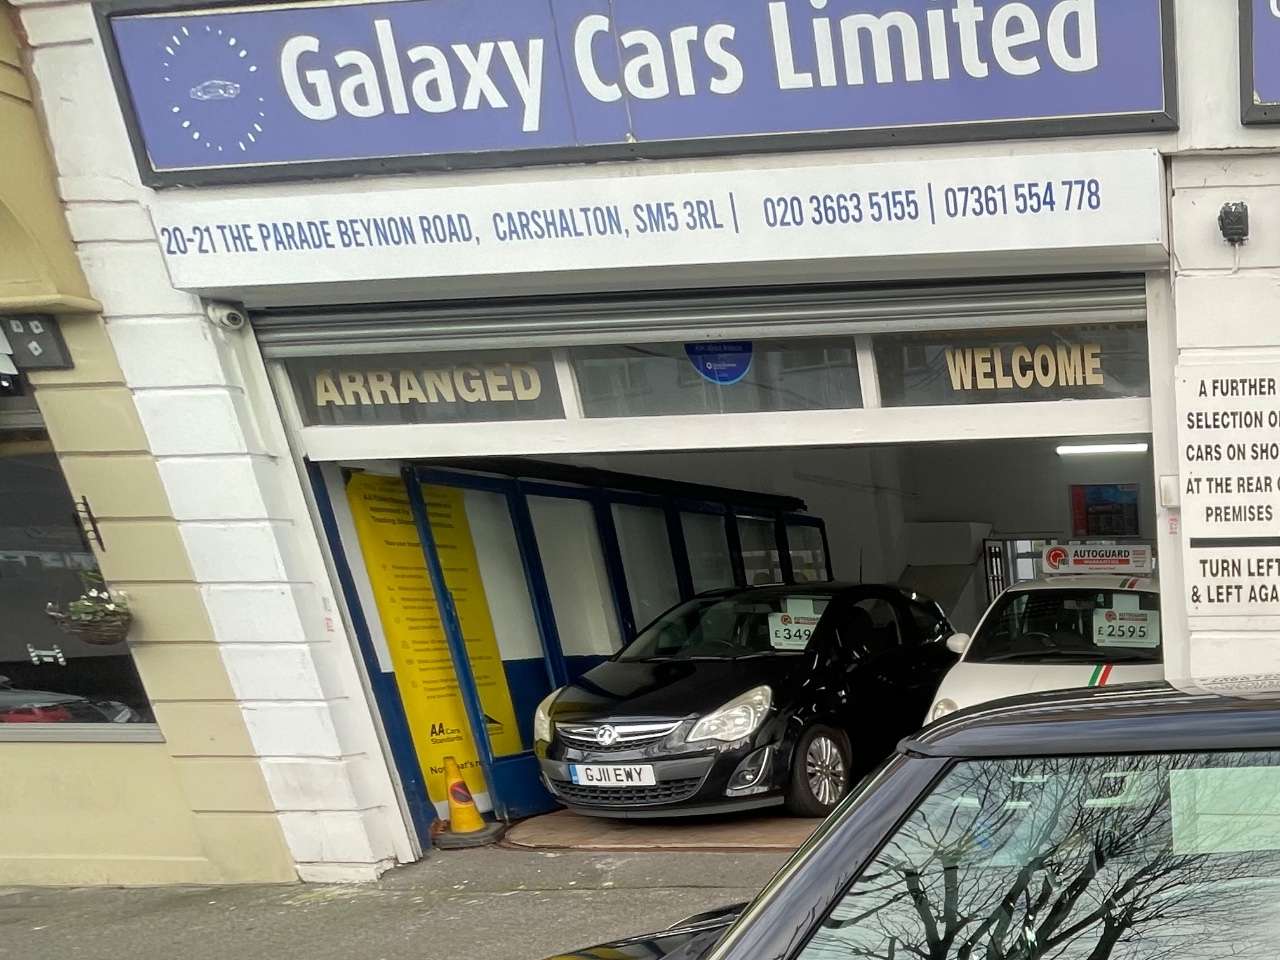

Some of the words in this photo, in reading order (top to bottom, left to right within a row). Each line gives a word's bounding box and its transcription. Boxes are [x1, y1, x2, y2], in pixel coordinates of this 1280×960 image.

[280, 19, 544, 132] Galaxy
[574, 14, 743, 102] Cars
[769, 0, 1098, 89] Limited
[161, 223, 218, 255] 20-21
[220, 223, 257, 254] THE
[261, 220, 332, 252] PARADE
[338, 216, 416, 249] BEYNON
[419, 213, 481, 247] ROAD,
[492, 205, 629, 243] CARSHALTON,
[633, 201, 678, 235] SM5
[685, 199, 724, 230] 3RL
[763, 195, 804, 228] 020
[811, 192, 863, 224] 3663
[868, 189, 919, 221] 5155
[944, 184, 1008, 218] 07361
[1015, 181, 1056, 214] 554
[1061, 178, 1101, 211] 778
[944, 343, 1104, 391] WELCOME
[315, 364, 542, 407] ARRANGED
[1199, 380, 1208, 398] A
[1212, 378, 1276, 397] FURTHER
[1187, 411, 1264, 429] SELECTION
[1186, 444, 1222, 461] CARS
[1227, 443, 1246, 461] ON
[1186, 478, 1202, 494] AT
[1206, 477, 1232, 494] THE
[1237, 476, 1272, 493] REAR
[1205, 505, 1273, 522] PREMISES
[1073, 549, 1130, 558] AUTOGUARD
[1200, 559, 1241, 577] TURN
[1191, 585, 1201, 603] &
[1207, 585, 1243, 603] LEFT
[431, 723, 445, 736] AA
[585, 767, 610, 782] GJ11
[613, 767, 642, 782] EWY
